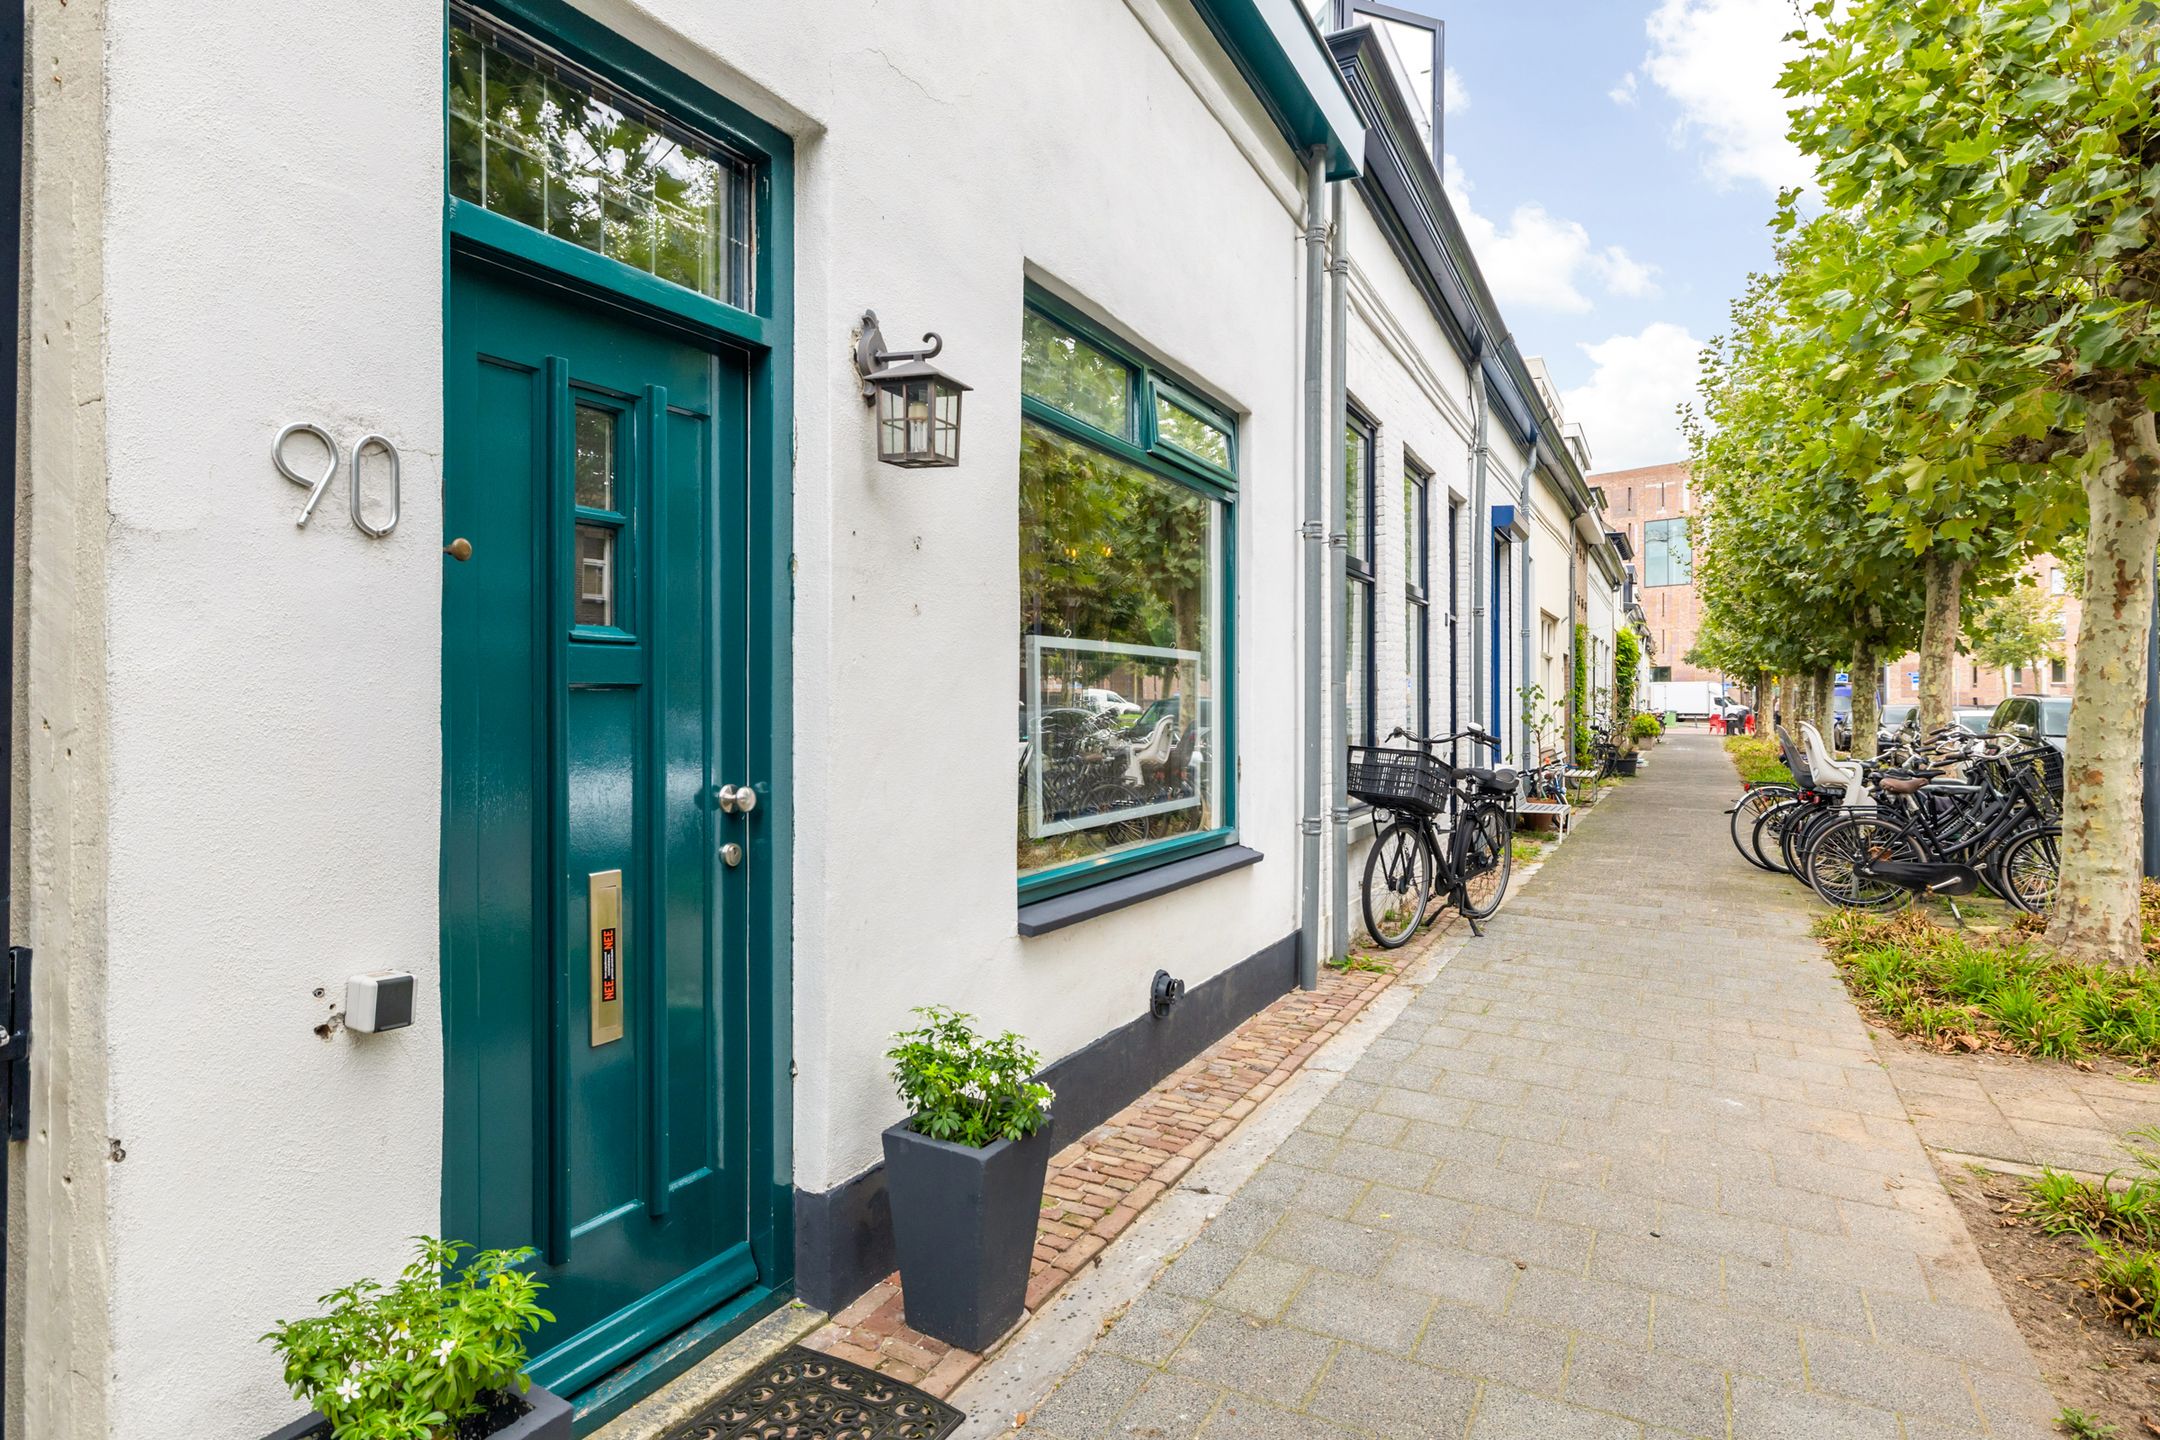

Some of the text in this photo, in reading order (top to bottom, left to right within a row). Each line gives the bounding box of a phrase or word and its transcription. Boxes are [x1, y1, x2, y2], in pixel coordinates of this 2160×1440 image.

[271, 421, 400, 539] 90
[603, 929, 614, 950] NEE
[604, 980, 615, 1000] NEE
